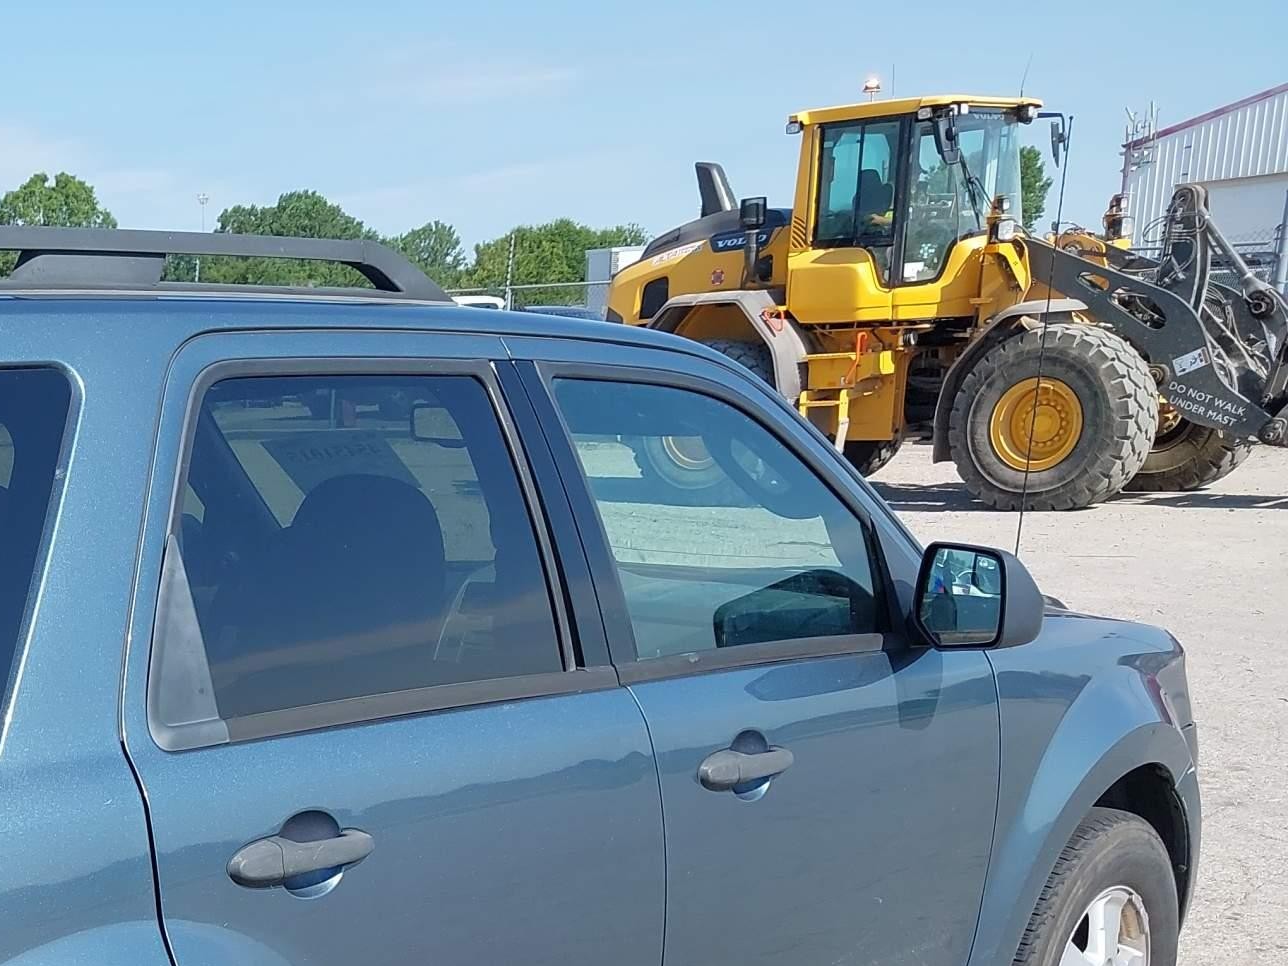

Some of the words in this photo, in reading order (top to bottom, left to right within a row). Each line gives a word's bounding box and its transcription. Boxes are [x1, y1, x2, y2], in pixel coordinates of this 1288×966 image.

[717, 234, 767, 248] VOLO
[1168, 381, 1186, 394] DO
[1188, 388, 1214, 403] NOT
[1214, 396, 1247, 417] WALK
[1169, 395, 1206, 416] UNDER
[1206, 410, 1238, 427] MAST
